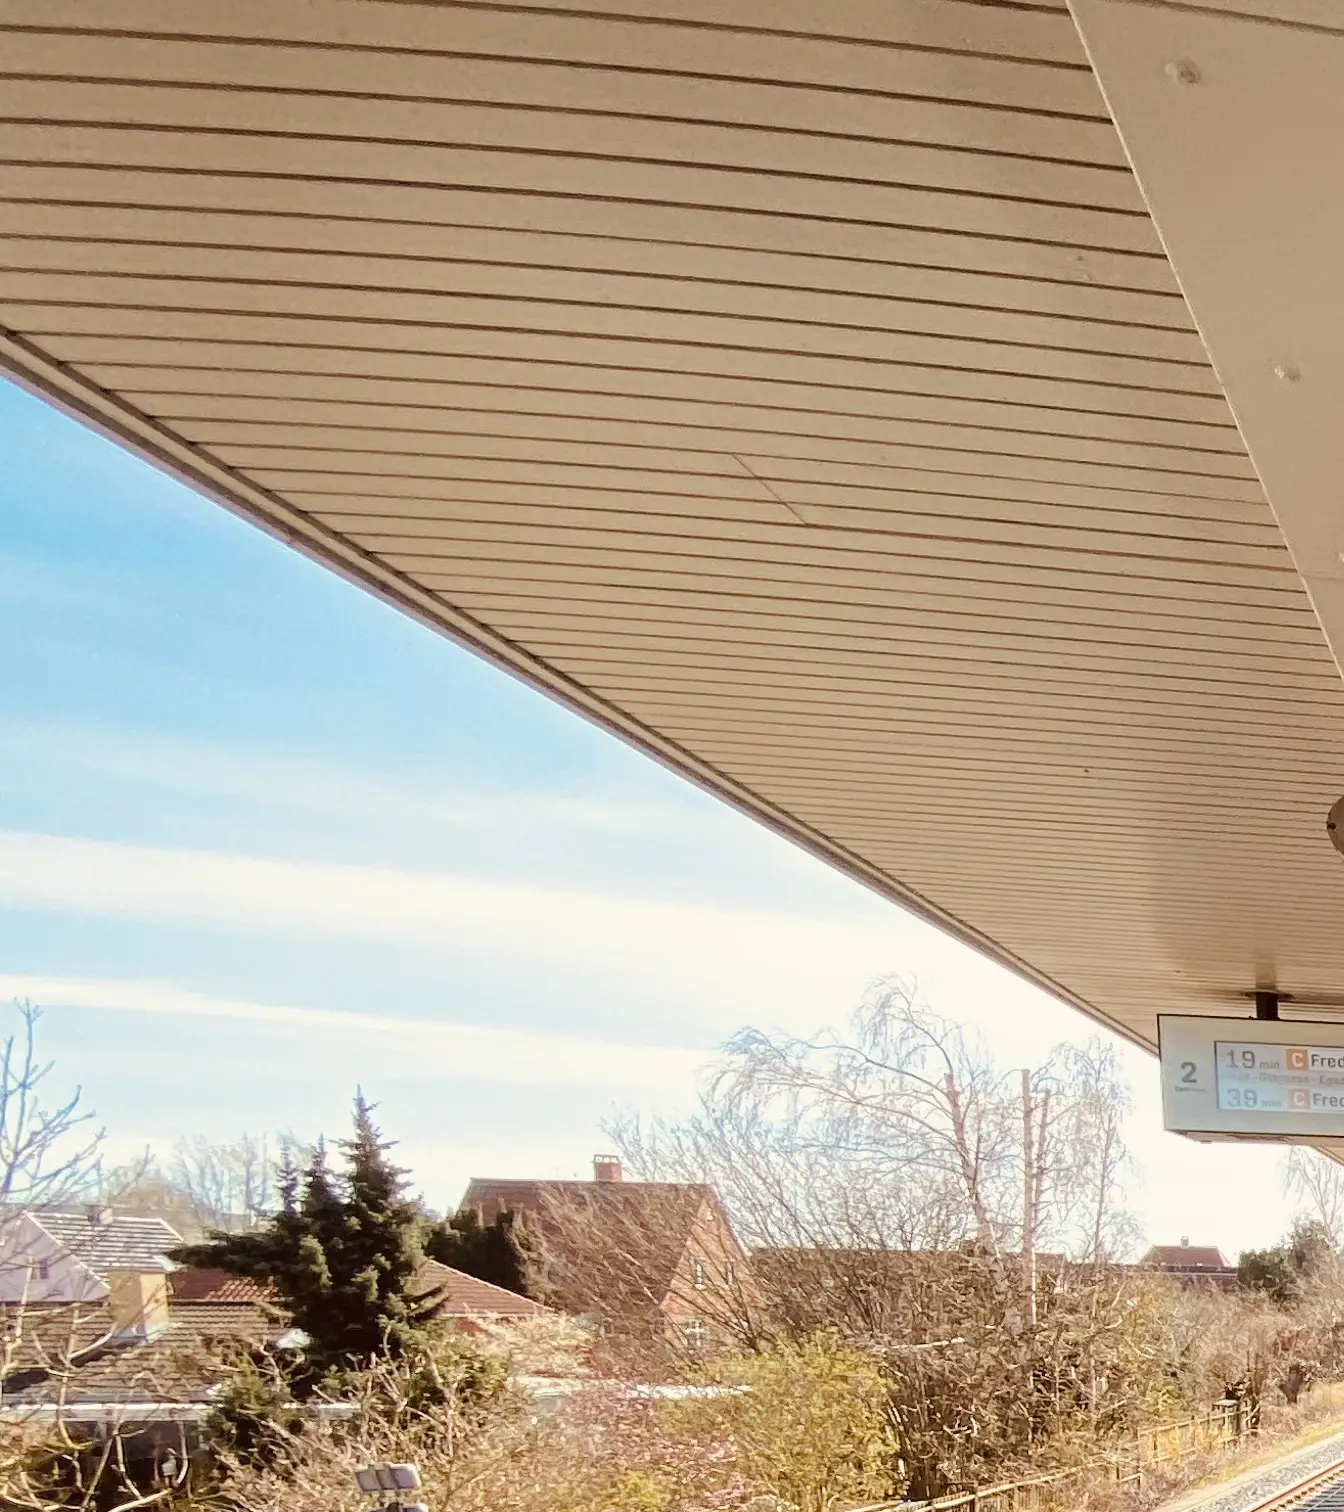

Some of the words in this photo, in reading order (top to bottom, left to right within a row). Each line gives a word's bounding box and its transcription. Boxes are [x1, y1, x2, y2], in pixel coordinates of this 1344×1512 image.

[1226, 1050, 1256, 1069] 19
[1291, 1052, 1304, 1068] C
[1181, 1062, 1197, 1083] 2
[1227, 1088, 1258, 1107] 39
[1293, 1091, 1306, 1106] C
